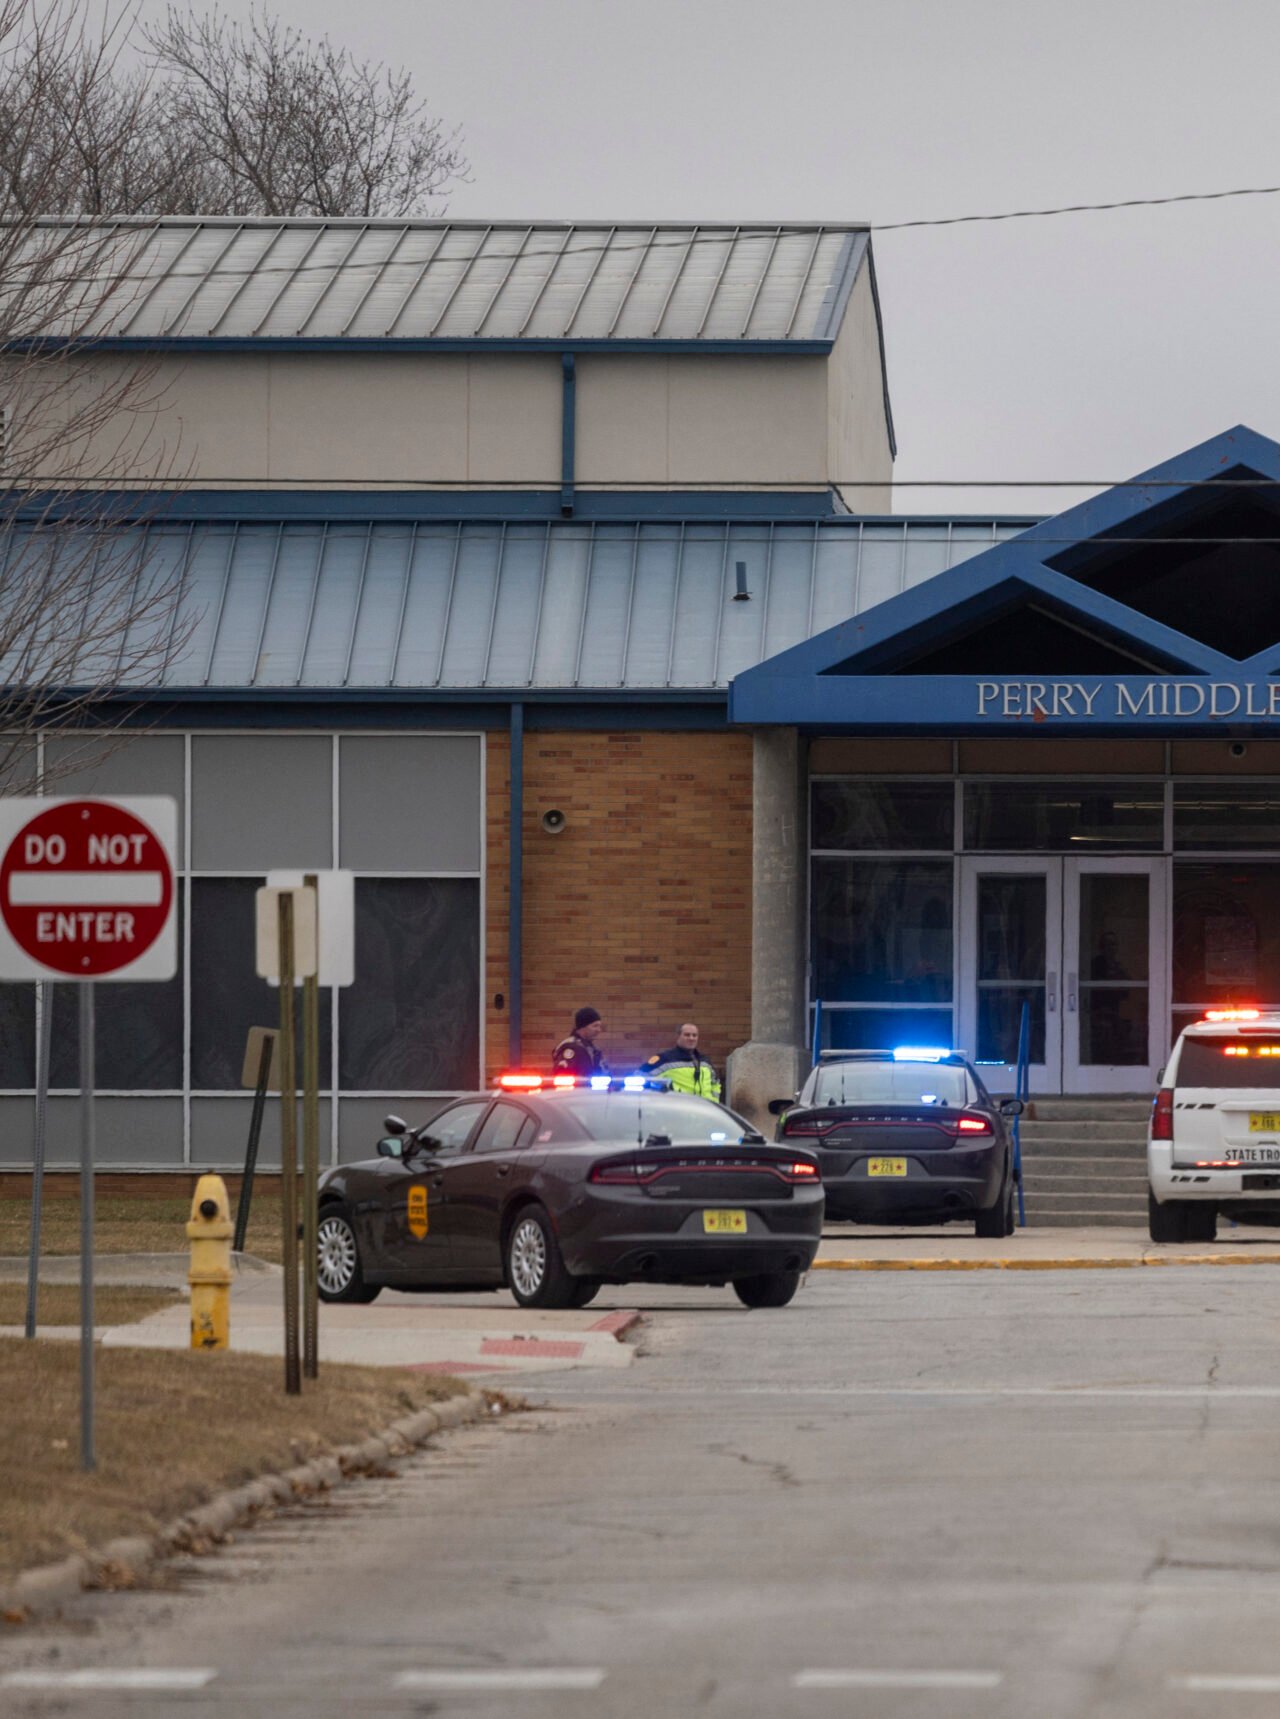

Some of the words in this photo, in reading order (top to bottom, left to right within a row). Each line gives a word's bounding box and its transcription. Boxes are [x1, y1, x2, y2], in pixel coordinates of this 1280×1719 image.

[976, 683, 1102, 716] PERRY
[24, 834, 66, 864] DO
[88, 834, 148, 864] NOT
[37, 912, 135, 942] ENTER
[1225, 1149, 1257, 1161] STATE
